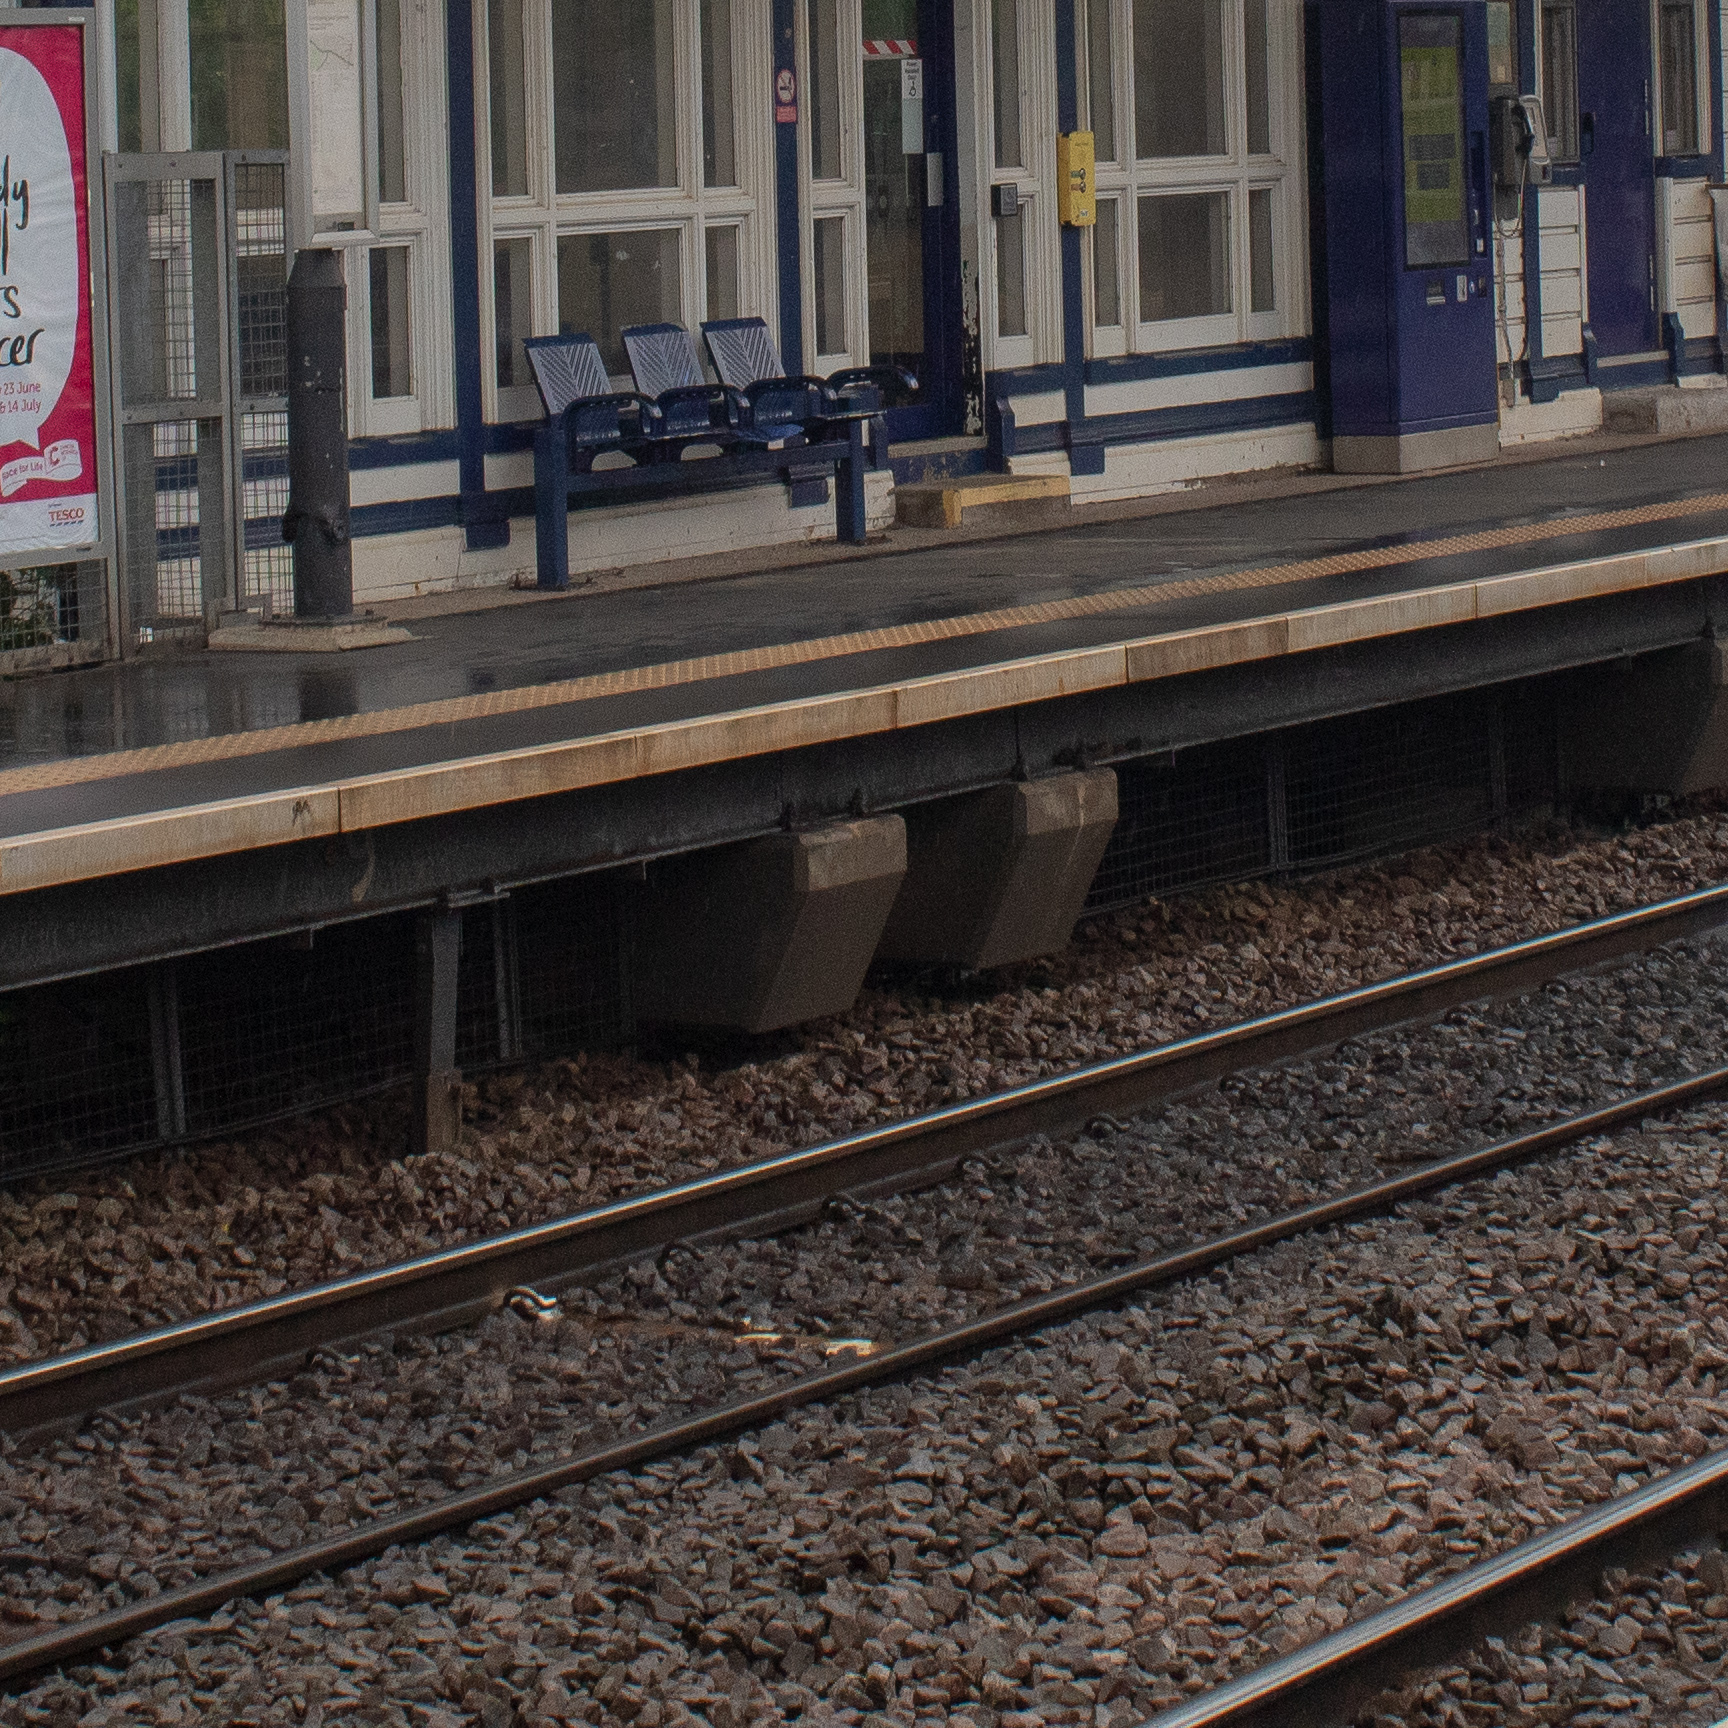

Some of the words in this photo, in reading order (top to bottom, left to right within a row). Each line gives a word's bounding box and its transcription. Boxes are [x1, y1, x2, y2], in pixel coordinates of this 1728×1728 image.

[3, 381, 14, 395] 23
[17, 381, 41, 394] June
[0, 401, 6, 414] &
[8, 399, 18, 413] 14
[21, 398, 41, 413] July
[48, 507, 85, 522] TESCO
